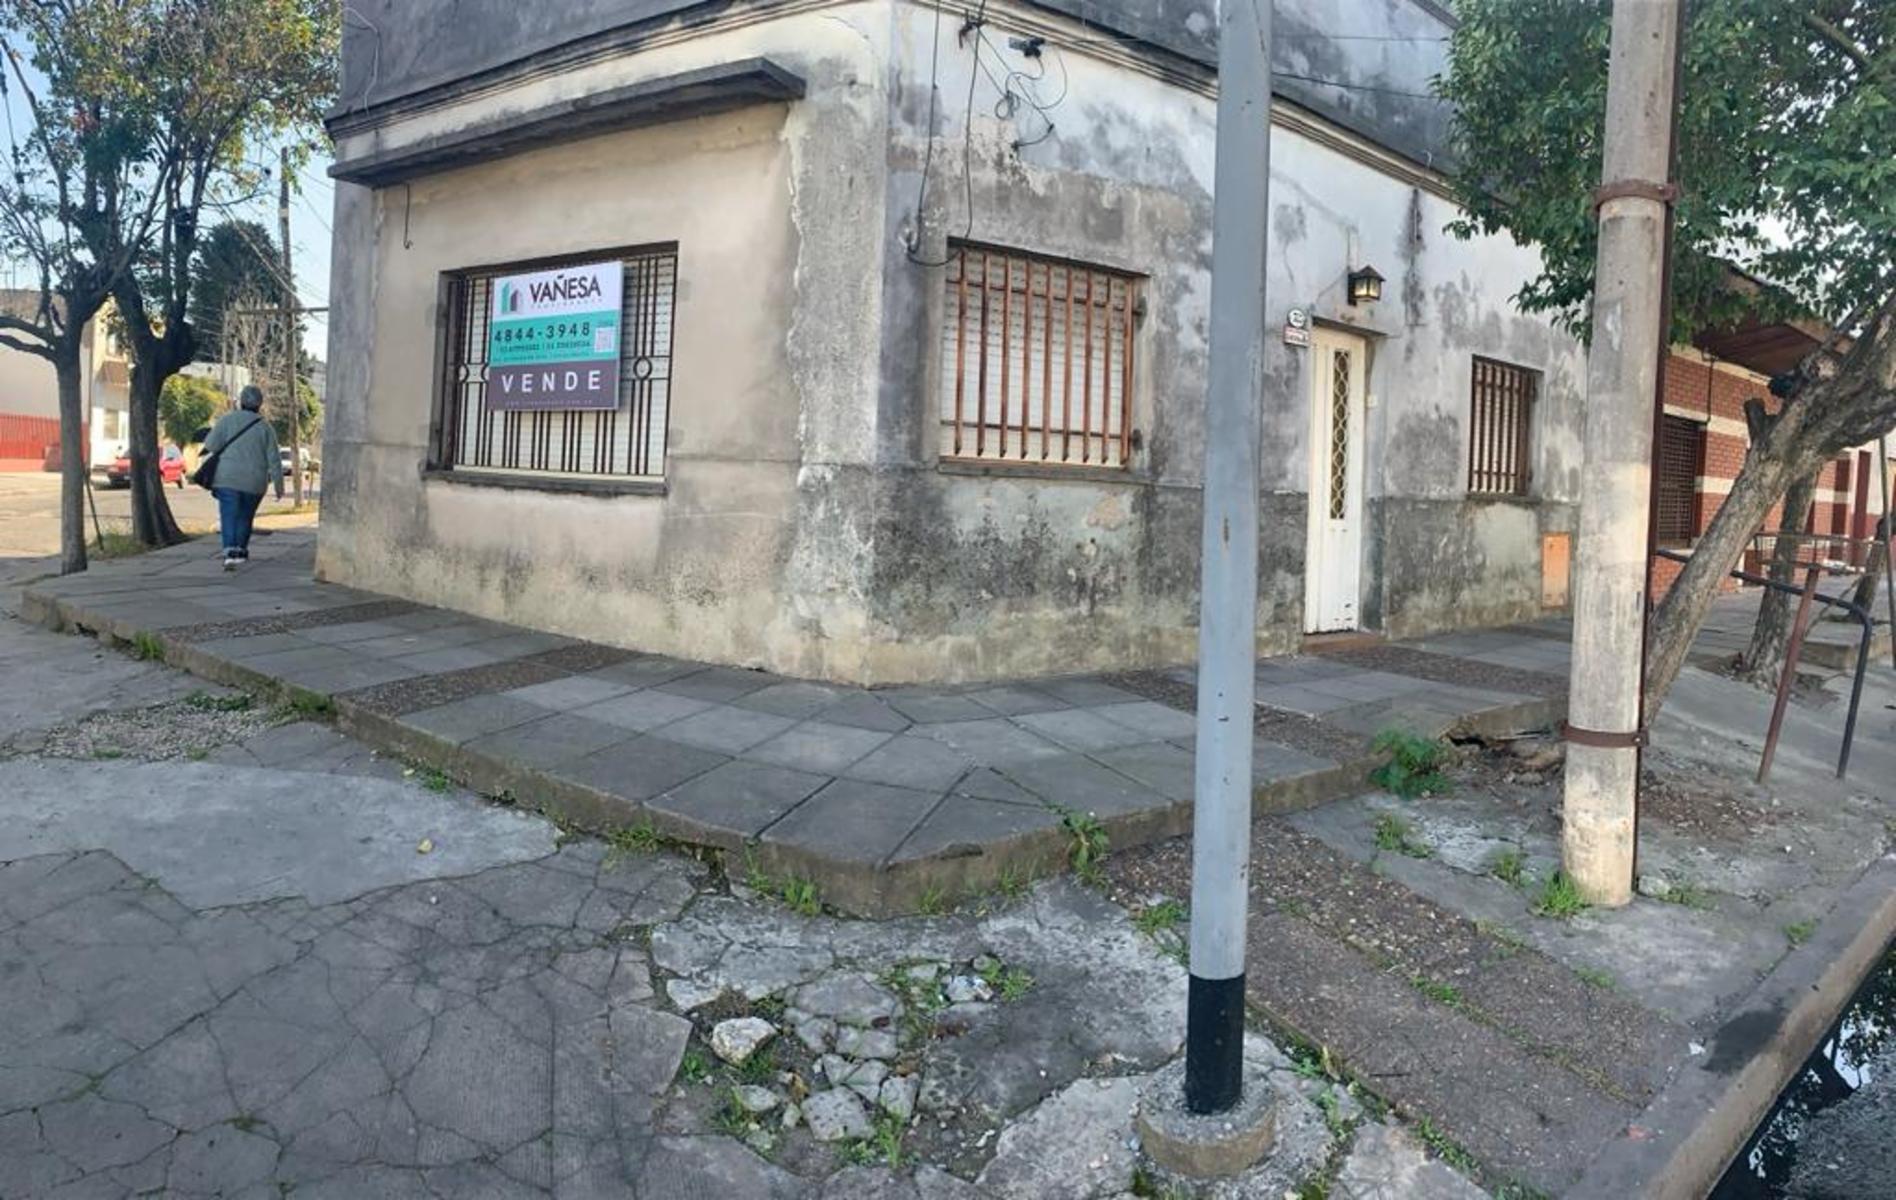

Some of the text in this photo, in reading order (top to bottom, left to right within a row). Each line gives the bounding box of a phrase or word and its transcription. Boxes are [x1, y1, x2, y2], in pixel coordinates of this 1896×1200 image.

[529, 274, 602, 303] VAÑESA
[494, 322, 591, 342] 4844-3948
[501, 370, 601, 393] VENDE
